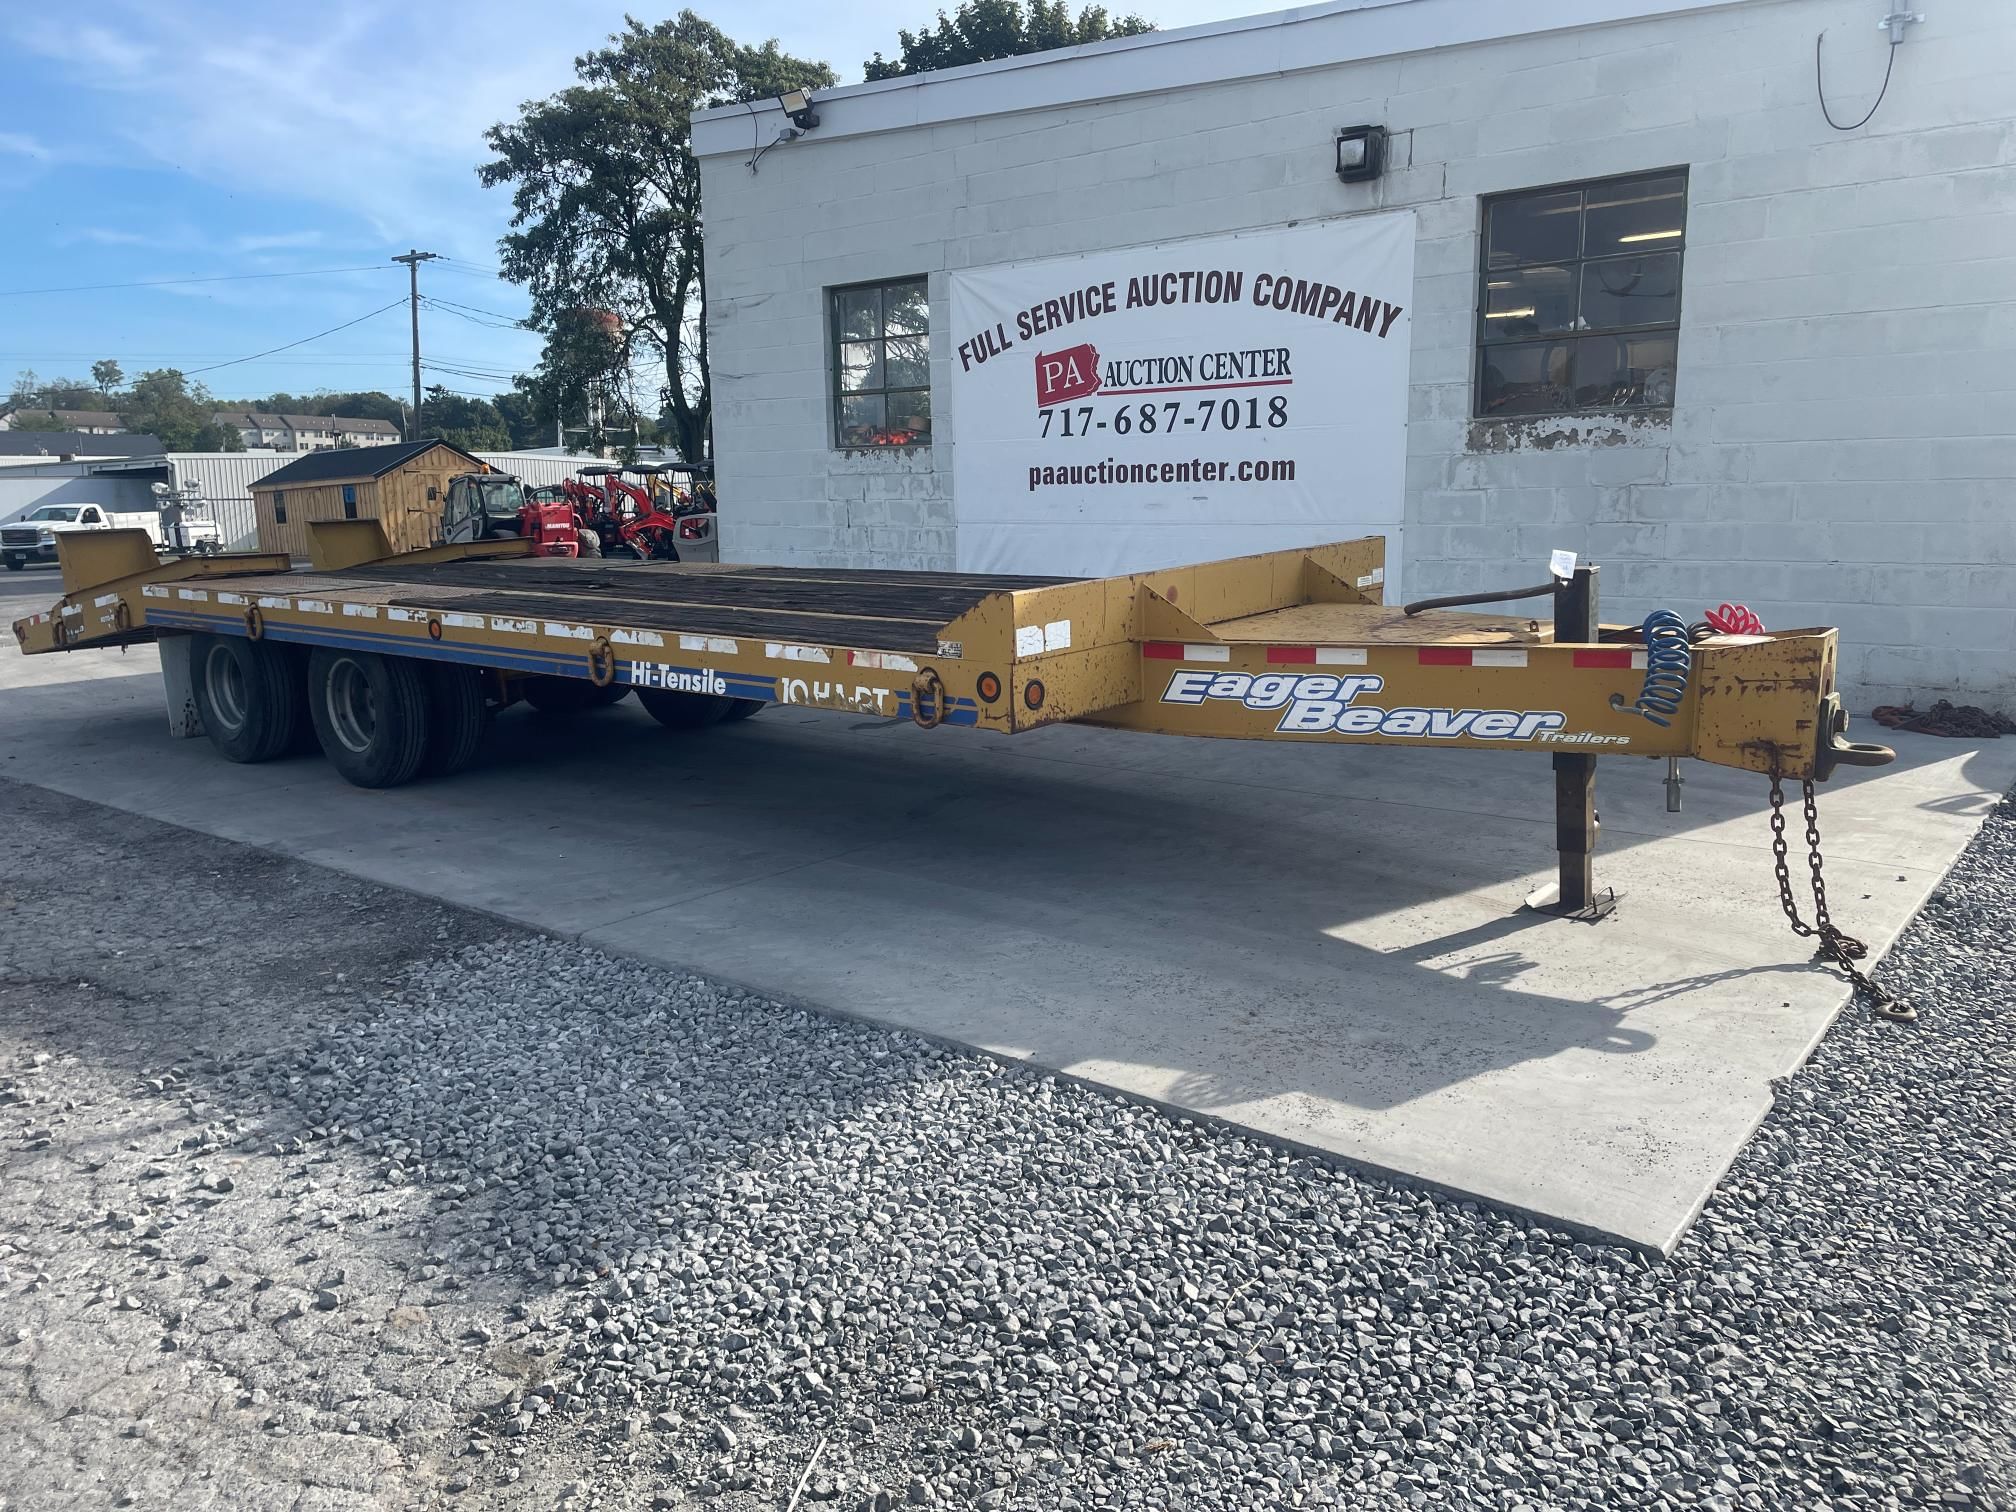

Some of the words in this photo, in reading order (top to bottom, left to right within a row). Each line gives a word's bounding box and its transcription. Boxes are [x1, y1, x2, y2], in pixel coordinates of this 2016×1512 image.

[958, 324, 1012, 372] FULL
[1017, 281, 1117, 341] SERVICE
[1126, 270, 1243, 309] AUCTION
[1253, 273, 1404, 339] COMPANY
[1043, 356, 1085, 393] PA
[1104, 355, 1194, 388] AUCTION
[1200, 347, 1292, 381] CENTER
[1038, 395, 1288, 439] 717-687-7018
[1029, 458, 1296, 491] paauctioncenter.com
[631, 660, 726, 695] Hi-Tensile
[1160, 669, 1384, 708] Eager
[1275, 699, 1567, 743] Beaver
[1537, 730, 1631, 745] Trailers
